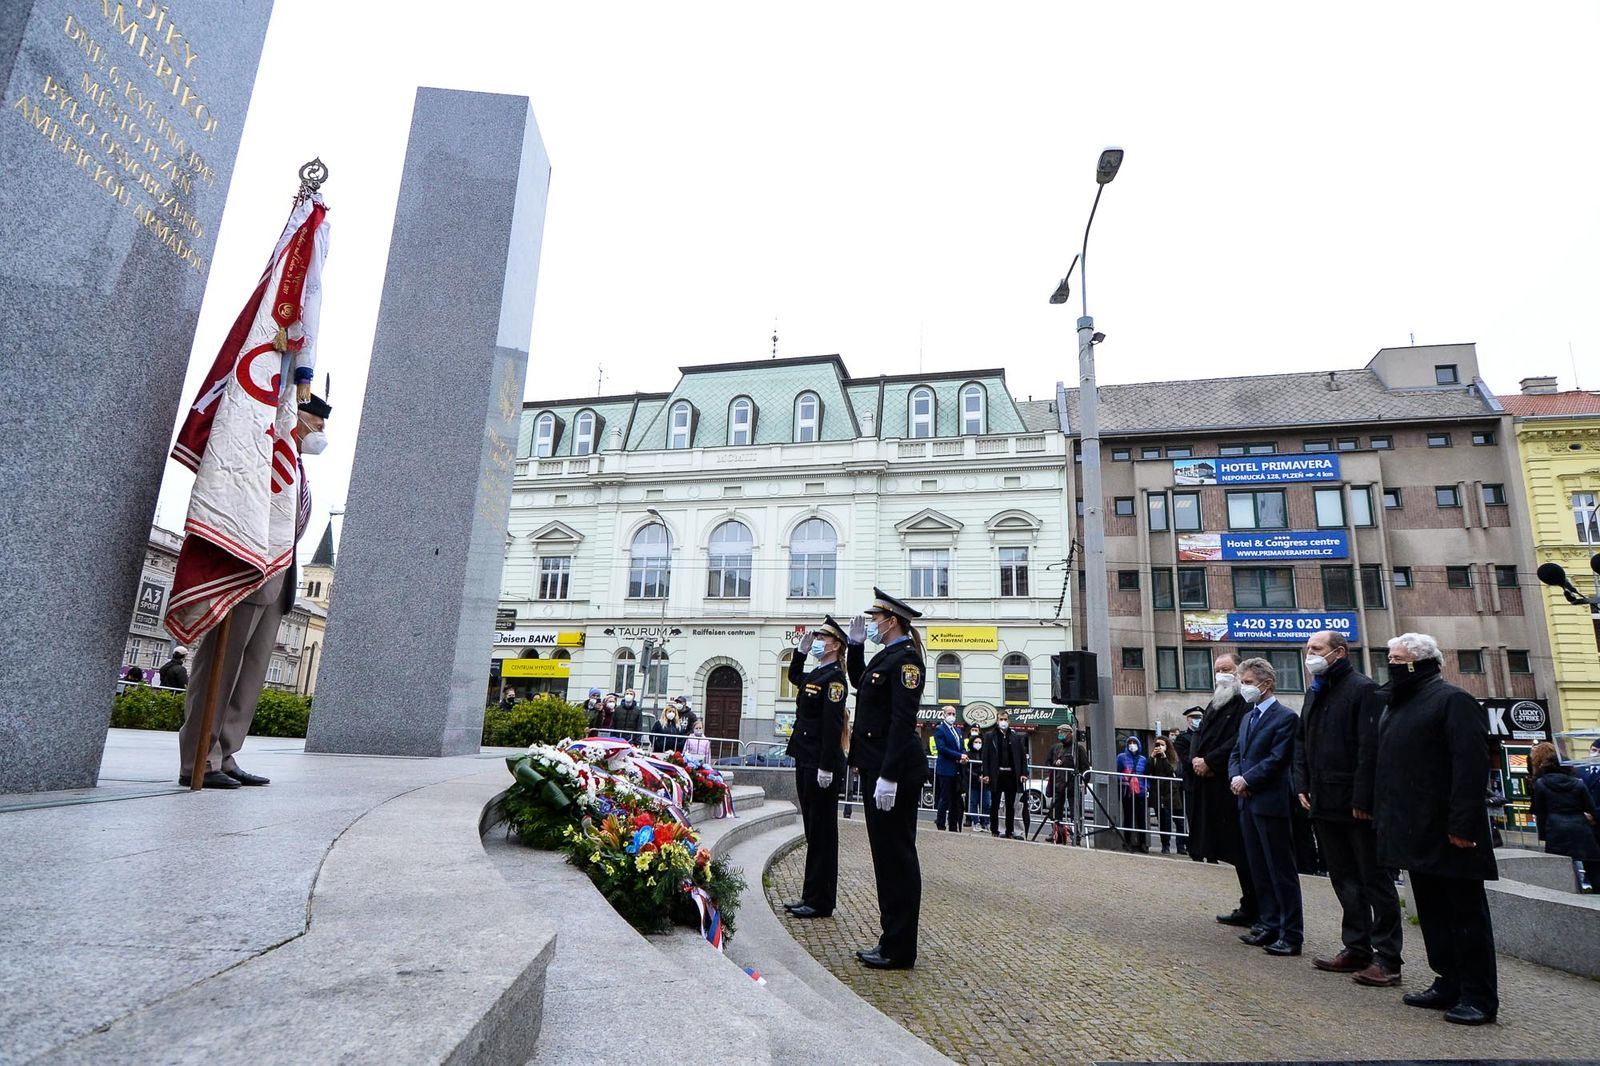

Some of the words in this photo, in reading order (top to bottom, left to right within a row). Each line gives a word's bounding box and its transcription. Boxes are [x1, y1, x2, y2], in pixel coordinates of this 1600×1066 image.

[43, 75, 96, 136] BYLO
[80, 71, 141, 144] MĚSTO
[14, 96, 132, 208] AMERICKOU
[1220, 462, 1259, 473] HOTEL
[1261, 459, 1333, 471] PRIMAVERA
[1226, 539, 1253, 548] Hotel
[1254, 539, 1264, 548] &
[1265, 538, 1309, 549] Congress
[1309, 538, 1341, 546] centre
[142, 587, 162, 604] A3
[140, 600, 159, 611] SPORT
[1233, 618, 1266, 630] +420
[1269, 618, 1294, 629] 378
[1296, 618, 1322, 629] 020
[1325, 618, 1350, 629] 500
[617, 627, 668, 636] TAURUM
[691, 628, 726, 636] Raiffeisen
[528, 634, 557, 644] BANK
